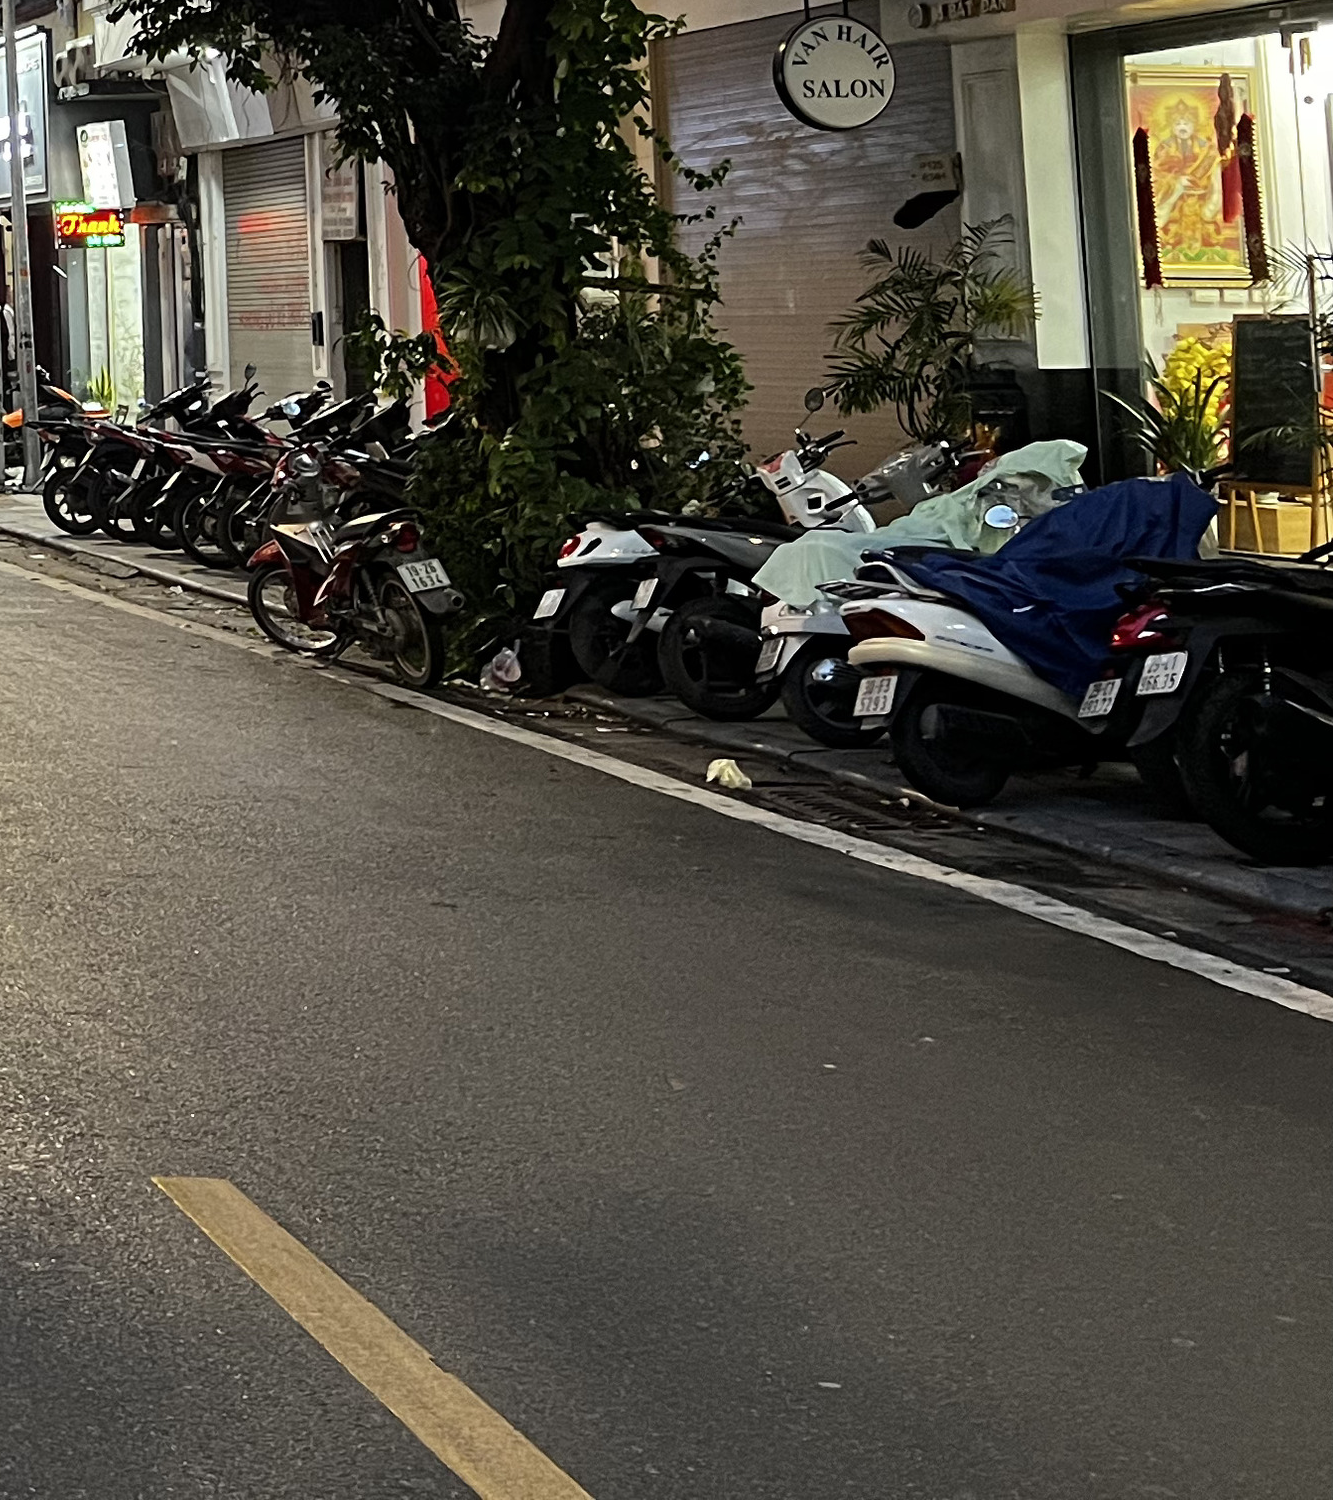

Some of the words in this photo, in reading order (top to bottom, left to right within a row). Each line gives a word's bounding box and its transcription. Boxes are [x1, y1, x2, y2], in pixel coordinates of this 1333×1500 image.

[791, 26, 830, 68] VAN
[836, 23, 890, 69] HAIR
[802, 78, 886, 100] SALON
